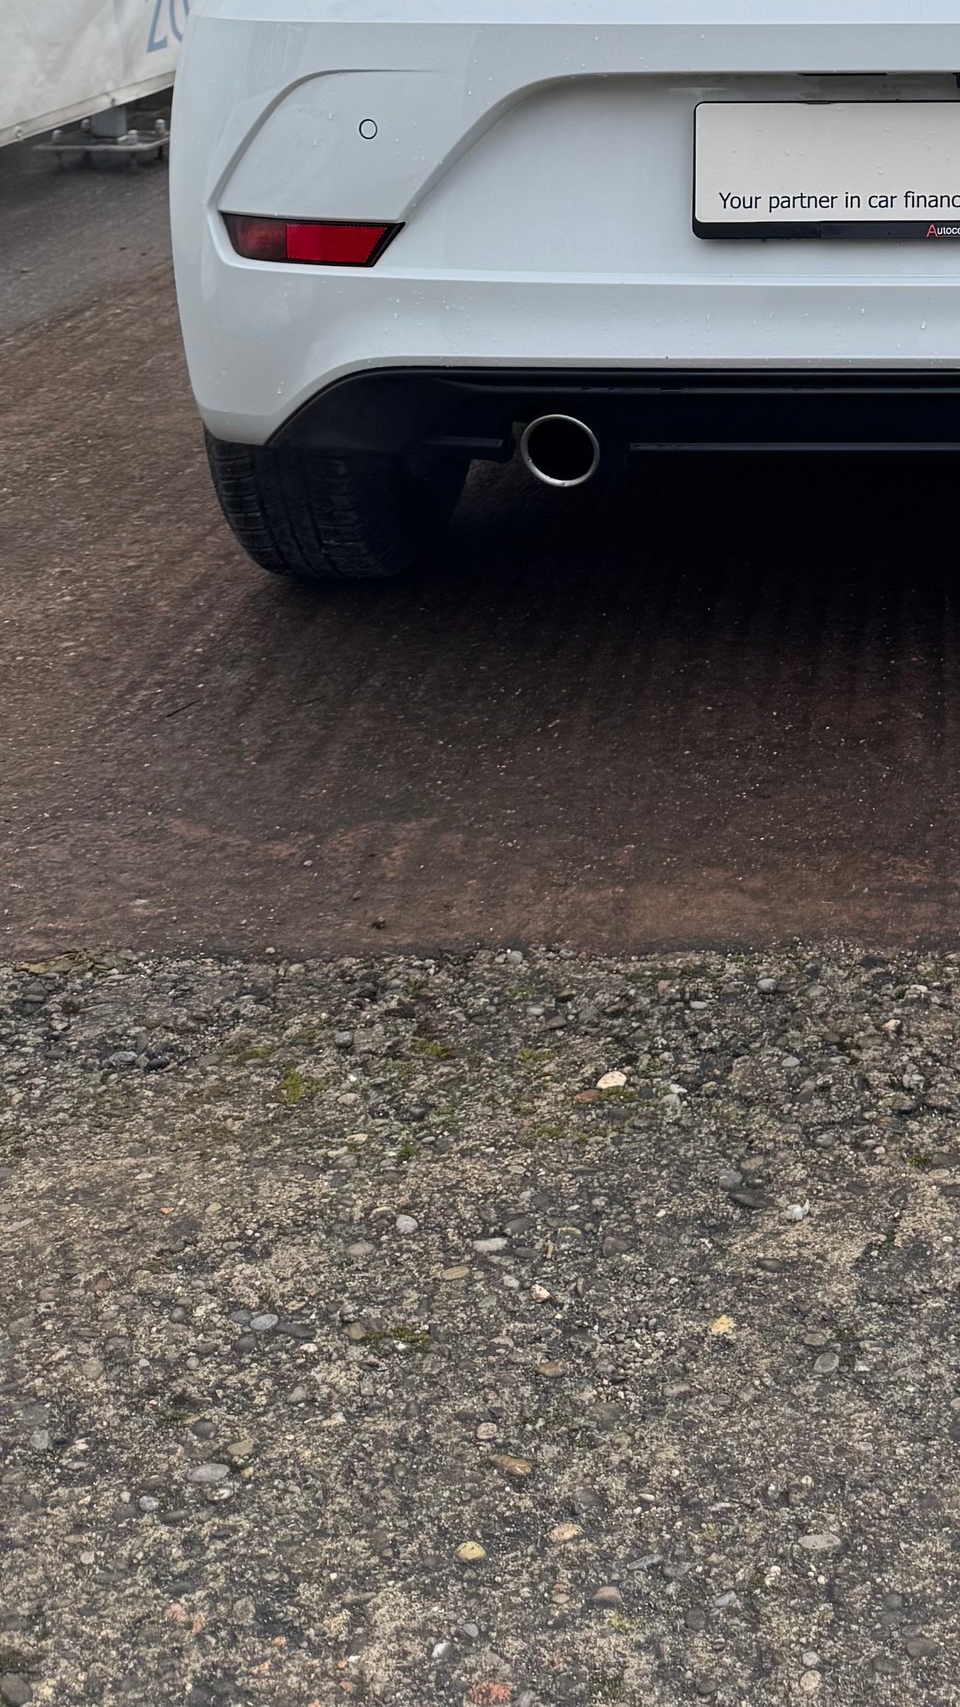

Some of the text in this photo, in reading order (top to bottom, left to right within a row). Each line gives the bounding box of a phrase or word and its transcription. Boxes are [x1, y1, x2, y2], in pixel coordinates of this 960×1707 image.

[719, 192, 762, 209] Your
[768, 193, 838, 213] partner
[844, 191, 861, 208] in
[868, 193, 897, 208] car
